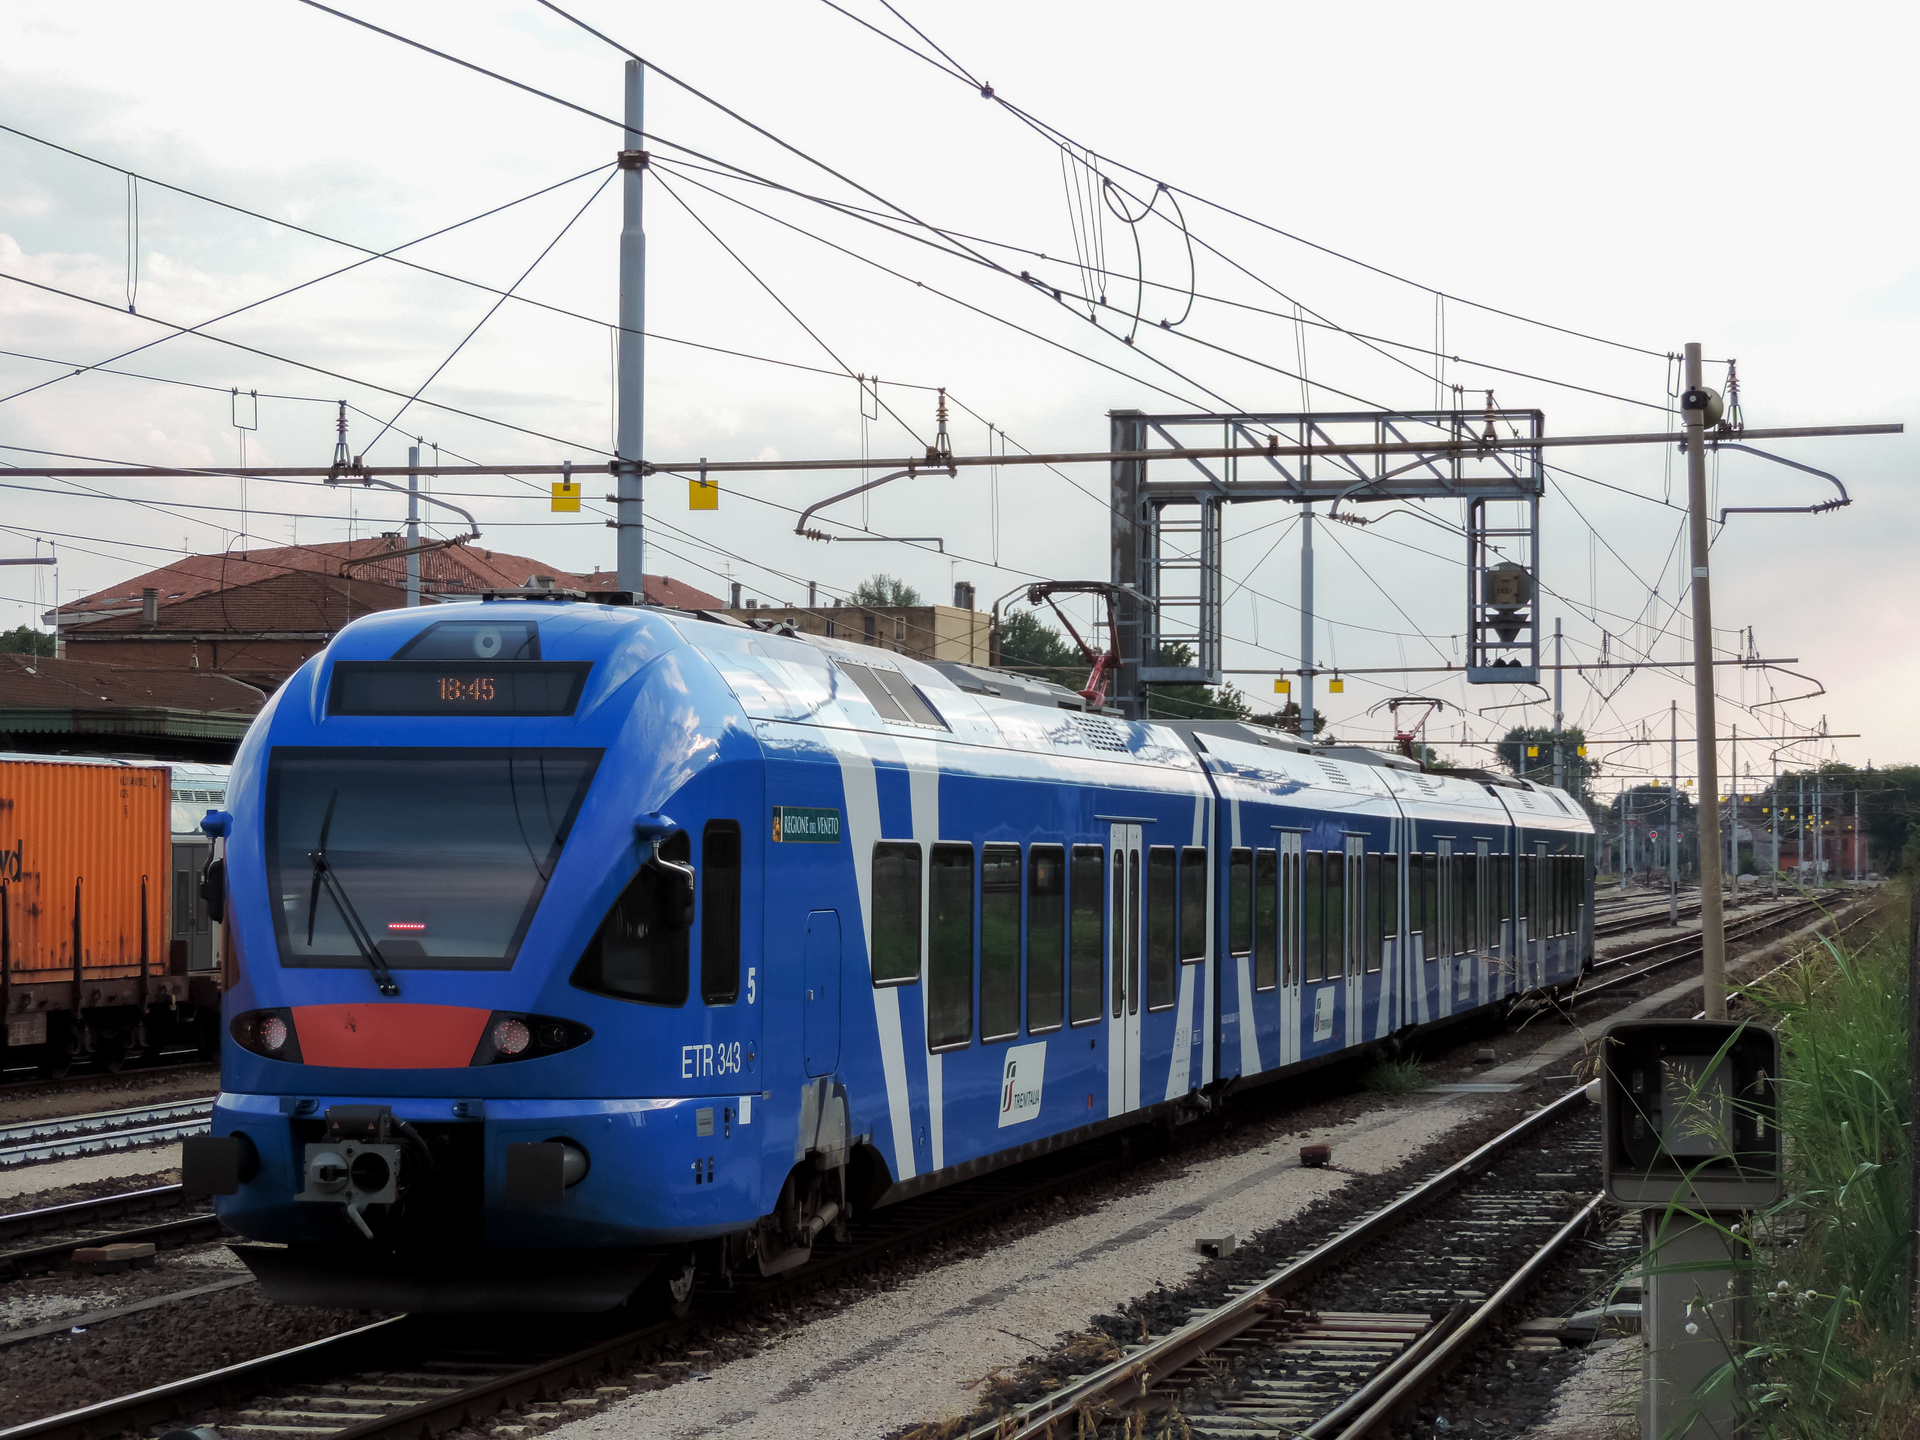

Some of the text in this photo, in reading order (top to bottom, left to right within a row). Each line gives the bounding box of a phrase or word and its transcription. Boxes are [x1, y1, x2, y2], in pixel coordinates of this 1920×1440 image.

[438, 678, 495, 700] 18:45
[784, 815, 809, 834] REGIONE
[816, 816, 839, 834] VENETO
[747, 967, 756, 1005] 5
[682, 1041, 741, 1079] ETR 343
